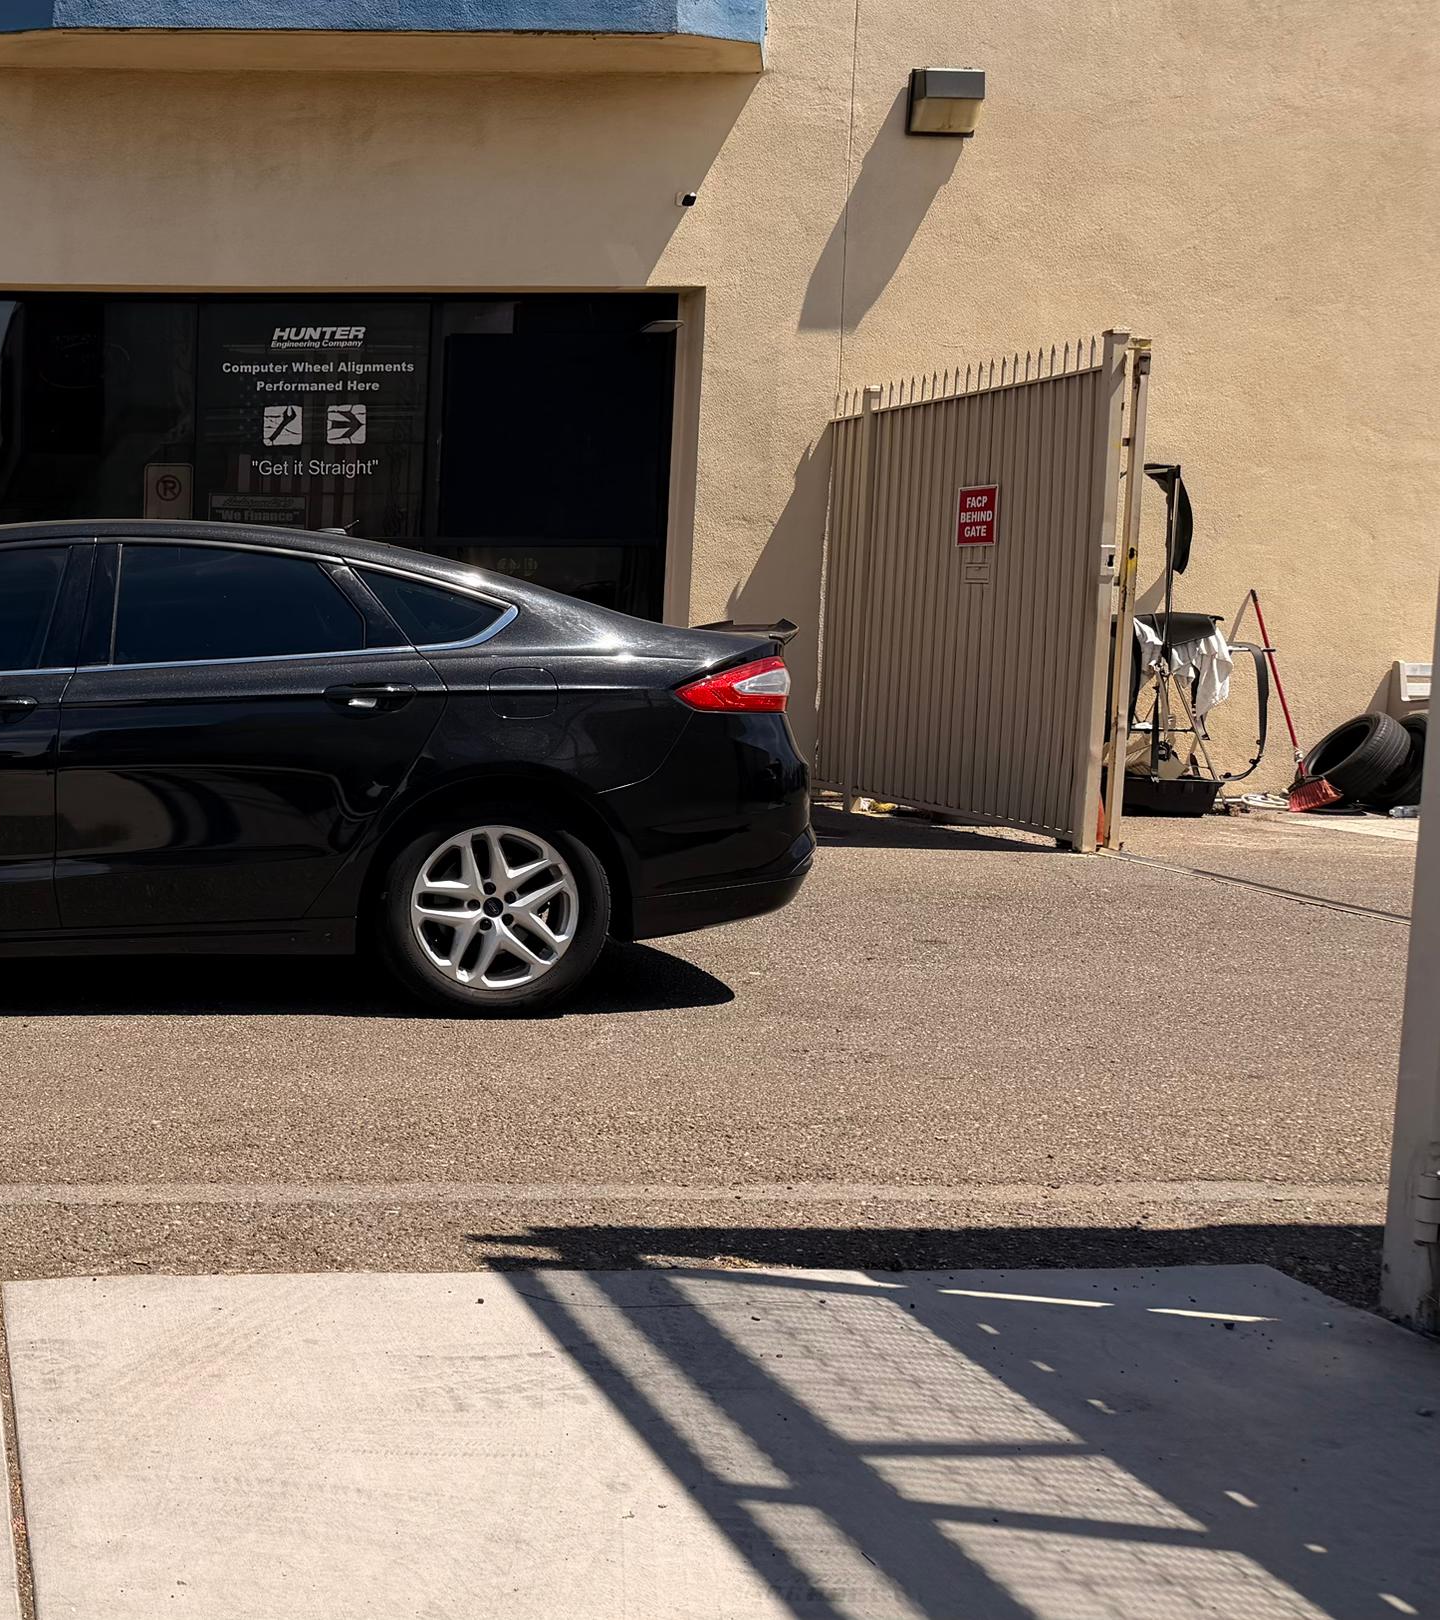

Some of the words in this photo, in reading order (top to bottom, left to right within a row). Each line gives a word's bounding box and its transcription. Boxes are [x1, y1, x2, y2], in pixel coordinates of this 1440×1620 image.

[272, 326, 366, 340] HUNTER
[271, 340, 320, 348] Engineering
[322, 340, 363, 348] Company
[222, 362, 289, 375] Computer
[292, 362, 333, 373] Wheel
[338, 361, 414, 374] Alignments
[256, 381, 343, 391] Performaned
[348, 380, 380, 391] Here
[252, 459, 288, 476] "Get
[294, 460, 303, 475] it
[308, 459, 379, 478] Straight"
[966, 496, 988, 508] FACP
[960, 510, 993, 523] BEHIND
[964, 525, 987, 537] GATE
